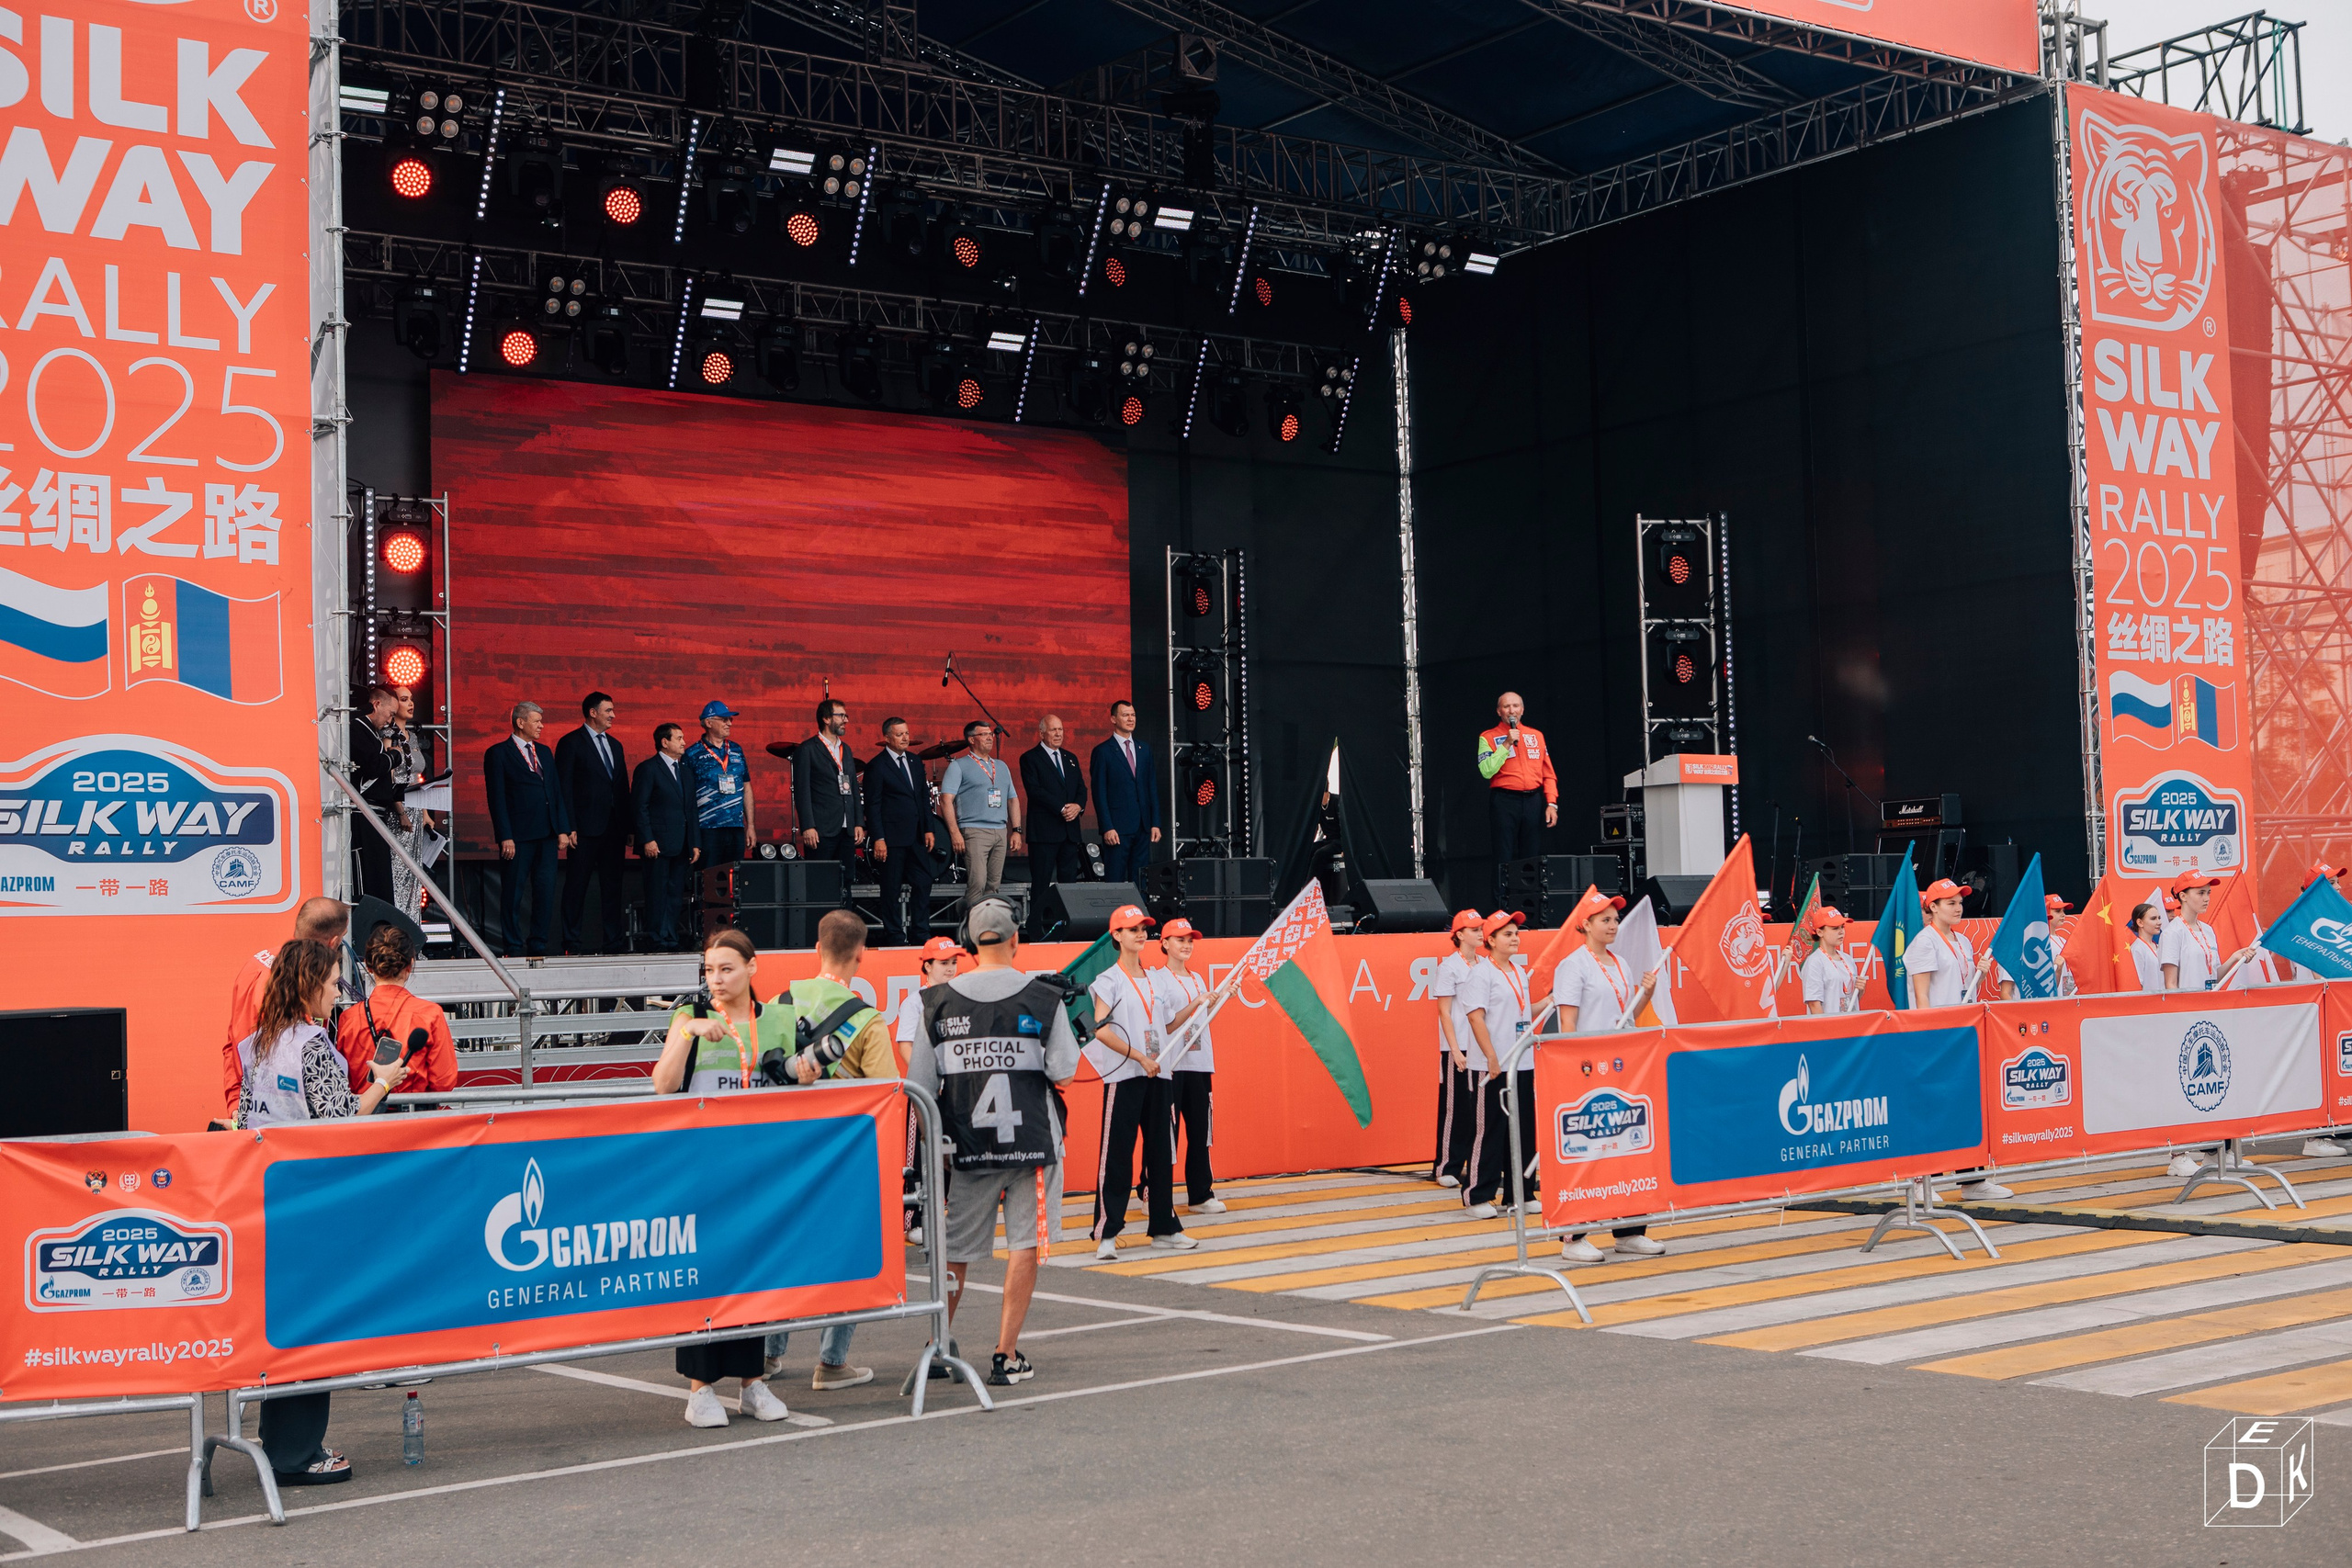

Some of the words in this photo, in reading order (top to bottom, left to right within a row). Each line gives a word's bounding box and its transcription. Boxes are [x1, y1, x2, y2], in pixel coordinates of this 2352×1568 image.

[0, 126, 277, 255] WAY
[0, 256, 277, 355] ALLY
[2094, 338, 2221, 414] SILK
[0, 347, 285, 472] 025
[2096, 407, 2222, 480] WAY
[2098, 483, 2225, 540] RALLY
[2103, 537, 2233, 612] 2025
[2107, 611, 2234, 667] 丝绸之路
[73, 772, 169, 794] 2025
[2161, 792, 2197, 806] 2025
[135, 801, 260, 836] WAY
[2129, 809, 2181, 830] SILK
[2184, 809, 2231, 830] WAY
[2160, 833, 2201, 842] RALLY
[67, 841, 178, 856] RALLY
[2133, 854, 2157, 864] GAZPROM
[0, 876, 55, 892] AZPROM
[76, 878, 169, 897] 一带一路
[219, 880, 254, 888] CAMF
[946, 1016, 970, 1027] SILK
[947, 1025, 971, 1036] WAY
[954, 1041, 1024, 1055] OFFICIAL
[963, 1055, 1015, 1069] PHOTO
[2008, 1068, 2038, 1084] SILK
[2040, 1066, 2063, 1080] WAY
[2188, 1081, 2224, 1097] CAMF
[972, 1073, 1023, 1144] 4
[1591, 1100, 1617, 1112] 2025
[1814, 1096, 1888, 1134] GAZPROM
[1566, 1113, 1606, 1132] SILK
[1607, 1108, 1643, 1127] WAY
[1589, 1127, 1623, 1137] RALLY
[2002, 1126, 2074, 1145] #silkwayrally2025
[958, 1150, 1046, 1164] www.silkwayrally.com
[1781, 1142, 1834, 1162] GENERAL
[1839, 1135, 1890, 1155] PARTNER
[1558, 1177, 1658, 1203] #silkwayrally2025
[102, 1227, 158, 1242] 2025
[552, 1213, 697, 1269] GAZPROM
[49, 1244, 132, 1268] SILK
[138, 1241, 210, 1264] WAY
[98, 1265, 162, 1277] RALLY
[55, 1288, 91, 1299] GAZPROM
[102, 1287, 156, 1299] 一带一路
[488, 1280, 588, 1309] GENERAL
[601, 1268, 698, 1295] PARTNER
[25, 1337, 234, 1367] #silkwayrally2025
